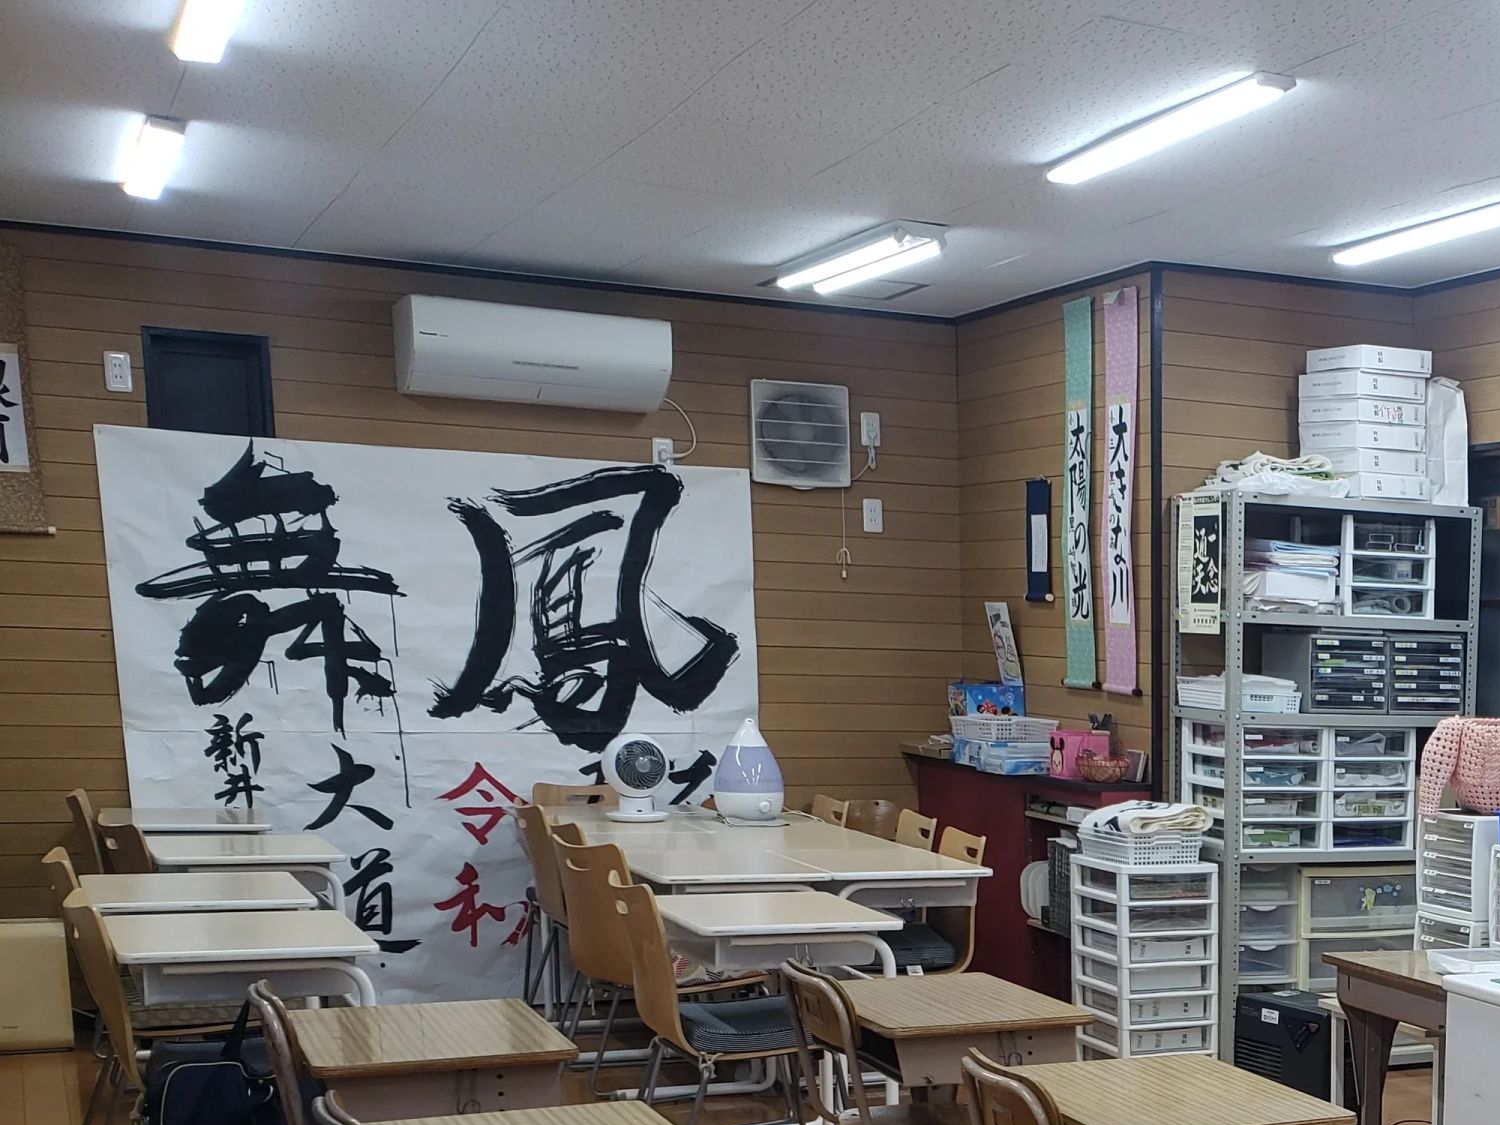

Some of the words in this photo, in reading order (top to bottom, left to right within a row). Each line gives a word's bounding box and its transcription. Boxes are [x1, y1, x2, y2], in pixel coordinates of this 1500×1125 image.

[1068, 410, 1090, 620] 太陽の光
[1109, 404, 1130, 614] 大きな川
[432, 761, 530, 947] 令和
